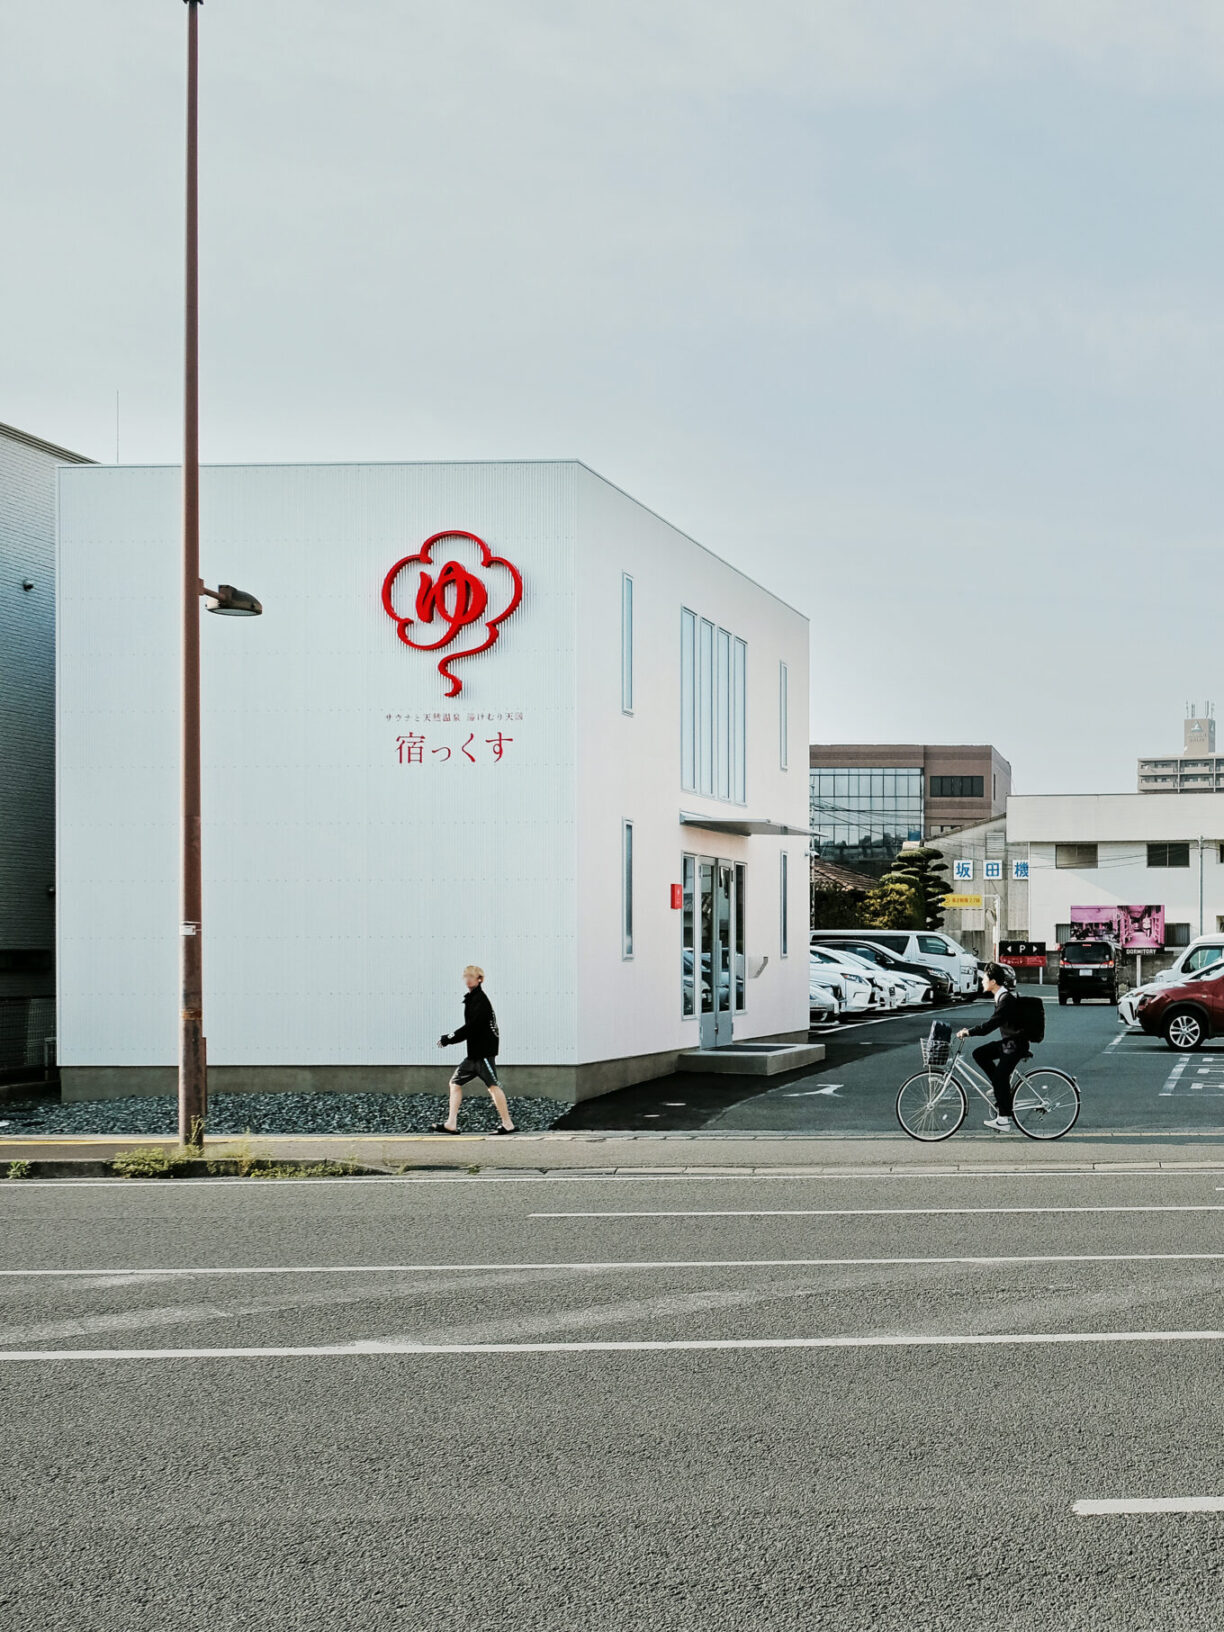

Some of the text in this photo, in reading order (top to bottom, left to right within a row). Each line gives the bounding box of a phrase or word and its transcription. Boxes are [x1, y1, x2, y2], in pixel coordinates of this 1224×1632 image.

[395, 731, 514, 764] 宿っくす
[1019, 944, 1026, 953] P
